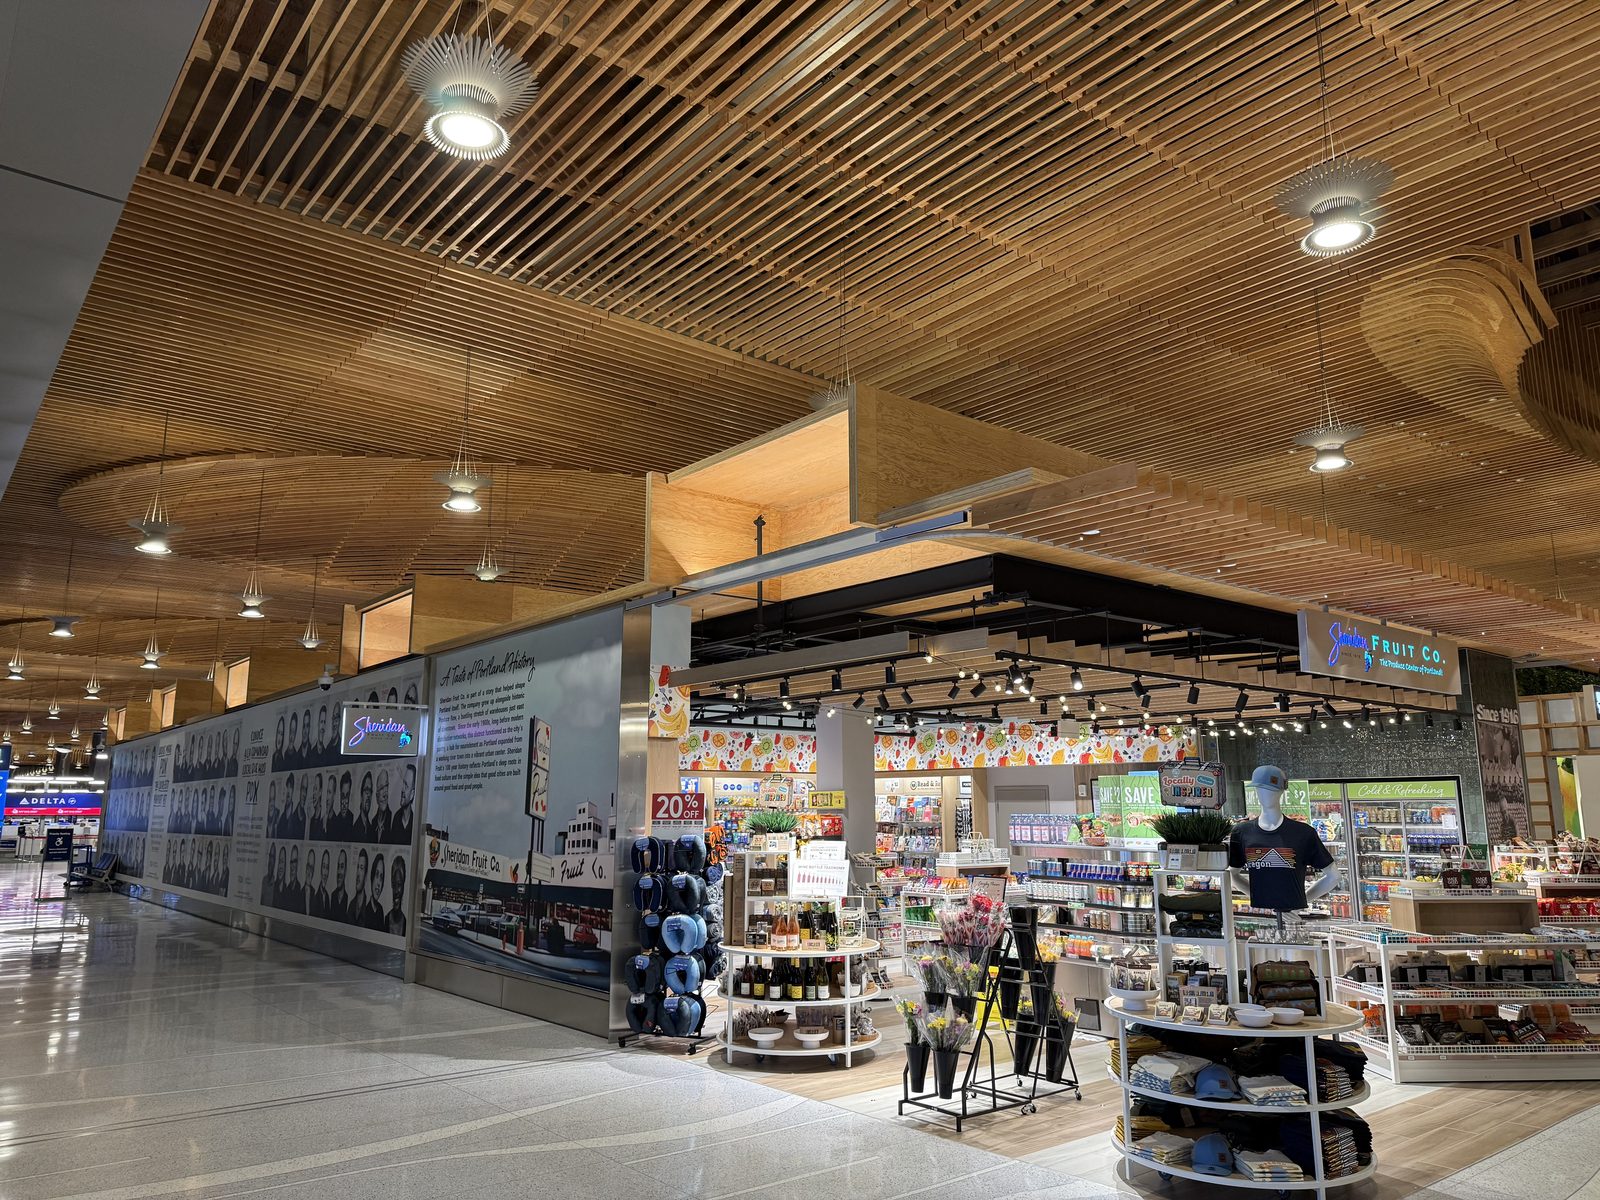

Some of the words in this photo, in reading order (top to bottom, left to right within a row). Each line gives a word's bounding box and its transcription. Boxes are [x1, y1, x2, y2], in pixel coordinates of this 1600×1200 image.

[1328, 622, 1368, 667] Sheridan
[1371, 634, 1415, 658] FRUIT
[439, 667, 451, 687] A
[451, 664, 466, 686] Taste
[475, 653, 509, 679] Portland
[508, 649, 535, 682] History
[1388, 660, 1405, 670] Produce
[1405, 662, 1419, 673] Center
[440, 696, 451, 704] Sheridan
[485, 688, 494, 697] story
[502, 684, 514, 694] helped
[515, 681, 525, 691] shape
[467, 702, 480, 710] company
[481, 700, 489, 708] grew
[495, 695, 511, 705] alongside
[512, 692, 525, 700] historic
[461, 712, 473, 721] bustling
[489, 706, 509, 714] warehouses
[472, 721, 480, 729] early
[491, 718, 499, 727] long
[511, 714, 524, 722] modern
[1476, 703, 1499, 722] Since
[1499, 707, 1519, 724] 1916
[348, 716, 405, 748] Sheridan
[485, 728, 502, 736] functioned
[460, 741, 478, 749] nourishment
[498, 737, 513, 747] expanded
[439, 754, 450, 763] working
[495, 748, 506, 756] center.
[507, 747, 522, 755] Sheridan
[458, 763, 469, 771] history
[499, 759, 507, 768] deep
[472, 783, 483, 791] people.
[1163, 776, 1194, 786] Locally
[246, 781, 259, 802] PDX
[1126, 786, 1155, 804] SAVE
[1172, 786, 1212, 797] INSPIRED
[1294, 789, 1307, 805] $2
[1358, 784, 1382, 797] Cold
[1382, 784, 1391, 795] &
[1392, 783, 1444, 798] Refreshing
[655, 794, 698, 818] 20%
[683, 810, 699, 818] OFF
[441, 843, 470, 867] Sheridan
[472, 850, 488, 870] Fruit
[490, 856, 501, 873] Co.
[560, 858, 584, 883] Fruit
